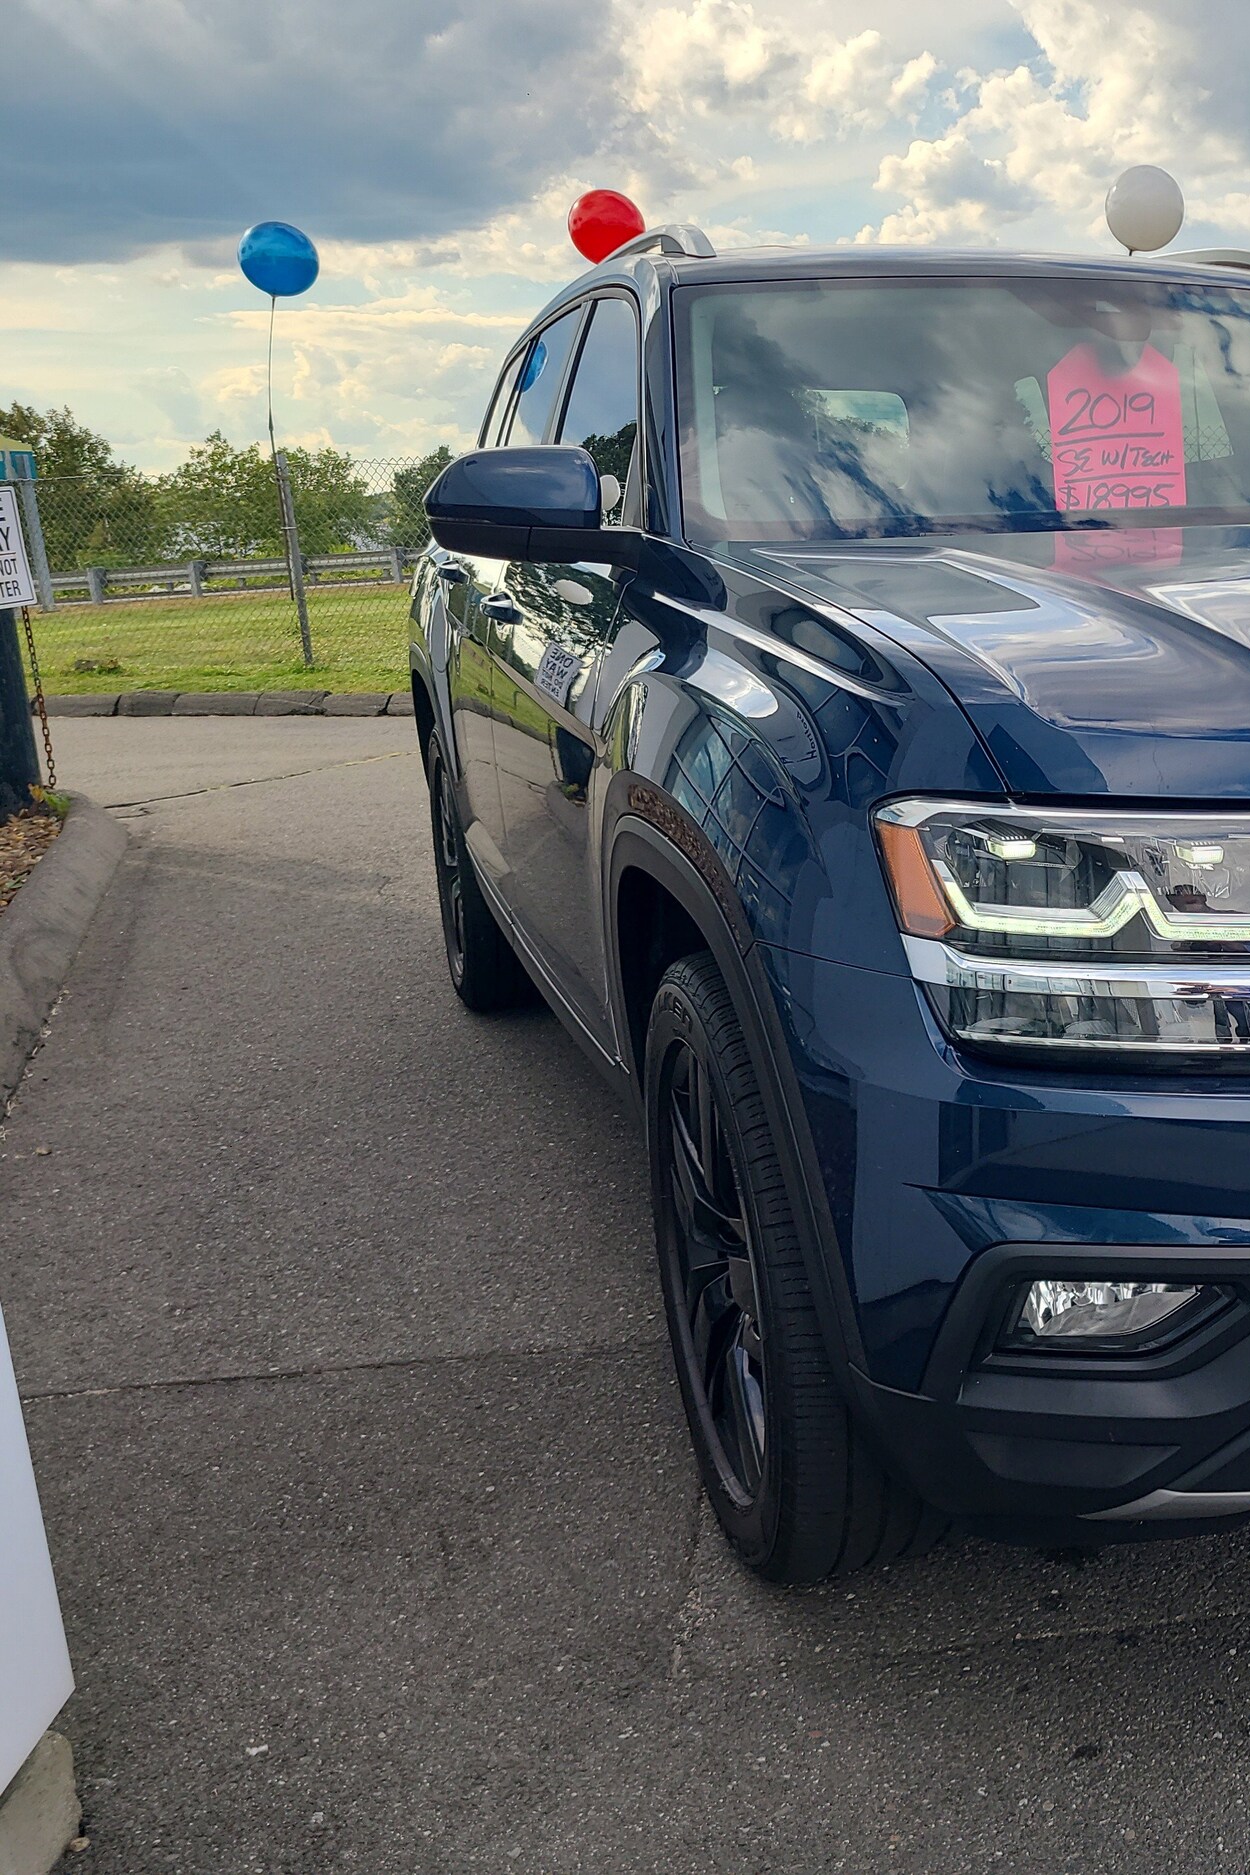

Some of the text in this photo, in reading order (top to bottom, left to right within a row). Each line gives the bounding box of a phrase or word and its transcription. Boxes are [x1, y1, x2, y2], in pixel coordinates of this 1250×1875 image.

[1058, 388, 1155, 435] 2019
[1057, 443, 1174, 477] SE W/TECH
[1058, 483, 1175, 510] $18995
[0, 580, 21, 598] TER
